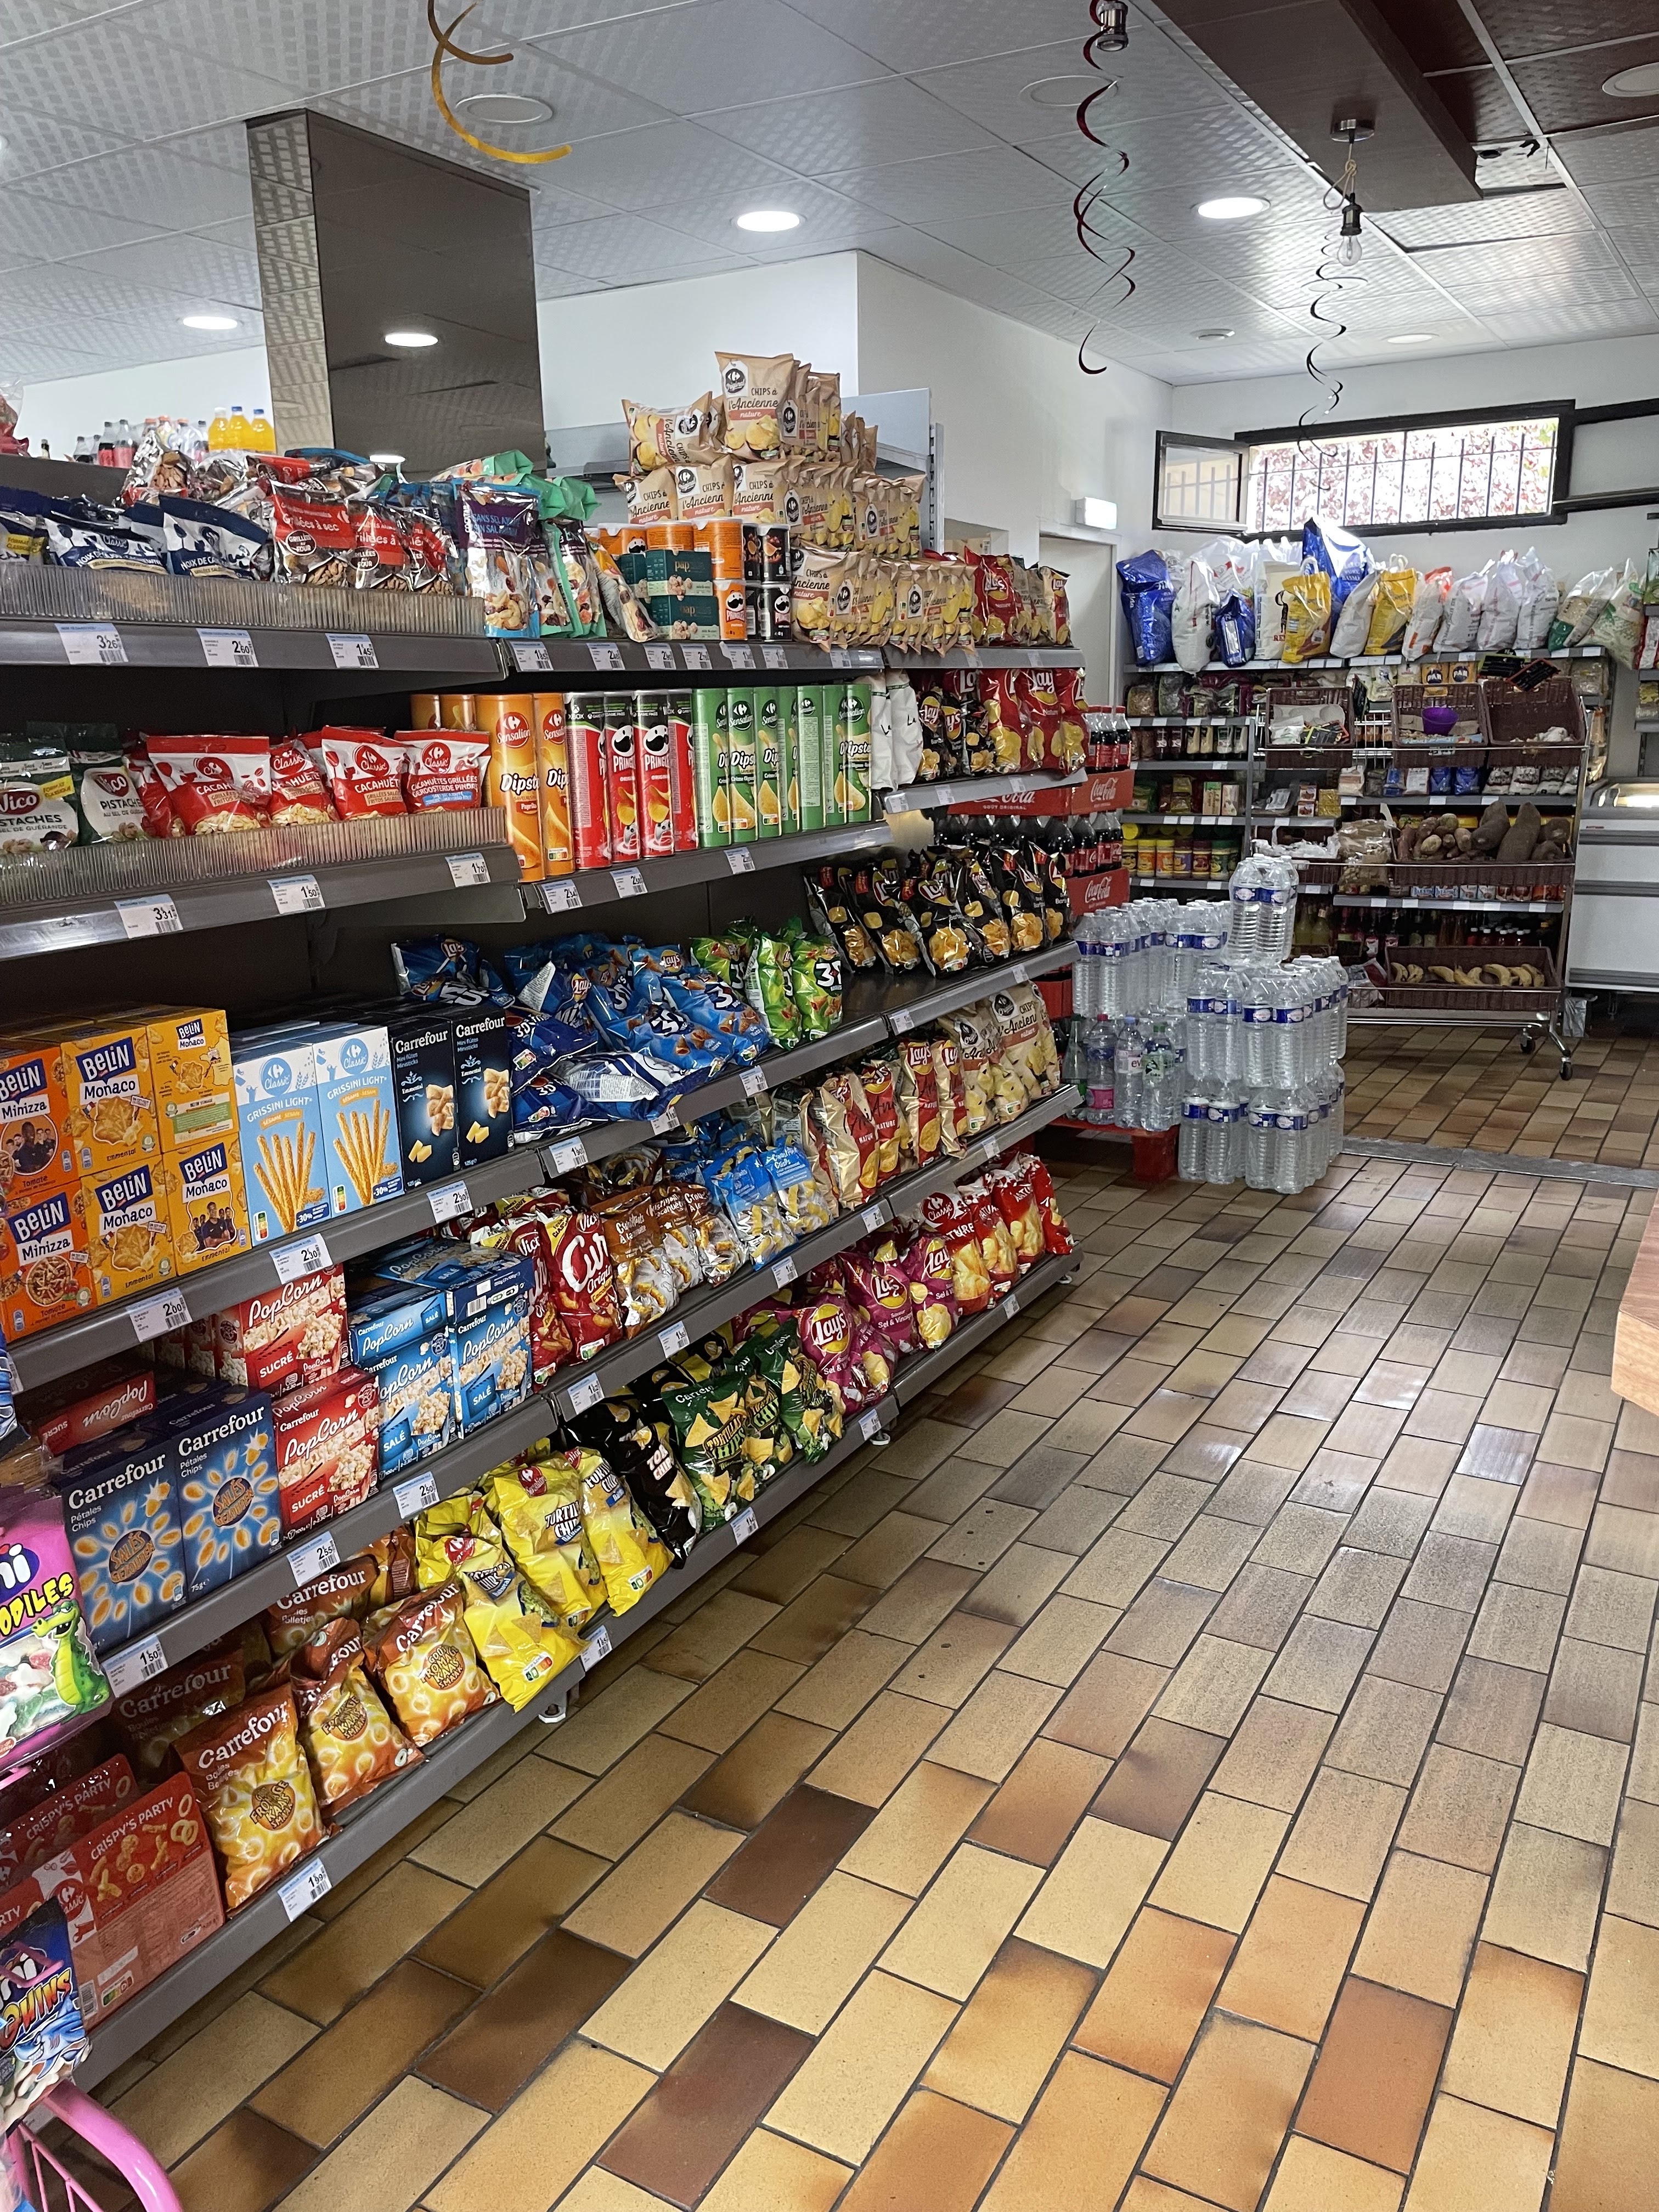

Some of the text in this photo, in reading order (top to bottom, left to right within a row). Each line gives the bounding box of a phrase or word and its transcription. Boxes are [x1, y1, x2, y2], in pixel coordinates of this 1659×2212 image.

[751, 388, 770, 396] CHIPS
[729, 398, 778, 410] l'Ancienne
[740, 410, 762, 419] nature
[703, 483, 721, 493] CHIPS
[749, 481, 768, 489] CHIPS
[643, 492, 661, 501] CHIPS
[682, 493, 725, 509] l'Ancienn
[695, 506, 715, 516] nature
[741, 504, 761, 512] nature
[639, 514, 658, 523] nature
[180, 558, 196, 571] NOIX
[497, 729, 531, 746] Sensation
[361, 760, 387, 771] Classic
[425, 758, 449, 768] Classic
[645, 754, 669, 771] PRINGLE
[411, 775, 477, 791] CACAHUÈTES GRILLÉES
[100, 798, 143, 810] PISTACHE
[0, 814, 63, 826] STACHES
[456, 1015, 505, 1037] Carrefour
[179, 1038, 204, 1048] Monaco
[396, 1029, 448, 1053] Carrefour
[344, 1055, 366, 1069] Classic
[1131, 1059, 1143, 1068] evi
[461, 1068, 481, 1077] Emmental
[84, 1079, 136, 1099] Monaco
[265, 1075, 291, 1090] Classic
[327, 1080, 361, 1099] GRISSINI
[402, 1084, 424, 1094] Emmental
[342, 1092, 359, 1104] SÉSAME
[2, 1099, 47, 1120] Minizza
[247, 1101, 283, 1122] GRISSINI
[263, 1114, 281, 1126] SÉSAME
[876, 1119, 895, 1131] NATURE
[186, 1180, 227, 1198] Monaco
[373, 1187, 388, 1197] -30%
[104, 1206, 153, 1229] Monaco
[297, 1212, 312, 1224] -30%
[928, 1203, 953, 1220] Classic
[946, 1223, 974, 1242] ATURE
[22, 1238, 70, 1260] Minizza
[202, 1246, 230, 1261] Emmental
[562, 1233, 608, 1293] Cur
[126, 1273, 153, 1288] Emmental
[439, 1267, 459, 1280] SALÉ
[249, 1274, 323, 1327] PopCorn
[935, 1291, 945, 1300] Sel
[425, 1312, 439, 1325] SALÉ
[458, 1314, 487, 1334] Carrefour
[878, 1320, 888, 1329] Sel
[358, 1321, 385, 1335] Carrefour
[362, 1318, 414, 1355] PopCorn
[462, 1317, 515, 1362] PopCorn
[260, 1352, 294, 1379] SUCRÉ
[303, 1358, 330, 1372] PopCorn
[824, 1367, 835, 1376] Sel
[380, 1358, 433, 1400] opCorn
[473, 1387, 492, 1406] SALÉ
[121, 1403, 153, 1421] Carrefour
[280, 1408, 319, 1432] Carrefour
[179, 1406, 264, 1457] Carrefour
[285, 1408, 358, 1465] PopCorn
[383, 1430, 406, 1452] SALÉ
[180, 1452, 207, 1470] Pétales
[181, 1465, 202, 1478] Chips
[69, 1453, 166, 1510] Carrefour
[213, 1479, 245, 1514] SALÉS
[291, 1486, 326, 1513] SUCRÉ
[333, 1488, 360, 1503] PopCorn
[71, 1504, 101, 1524] Pétales
[71, 1519, 97, 1532] Chips
[110, 1531, 148, 1570] SALÉS
[278, 1569, 366, 1609] Carrefour
[0, 1572, 74, 1637] ODILES
[433, 1659, 460, 1683] KAAS
[438, 1667, 464, 1689] SMAAK
[119, 1663, 232, 1718] Carrefour
[198, 1701, 289, 1769] Carrefour
[26, 1781, 111, 1840] CRISPY'S PARTY
[266, 1793, 290, 1821] KAAS
[271, 1803, 293, 1829] SMAAK
[91, 1797, 174, 1860] CRISPY'S PARTY
